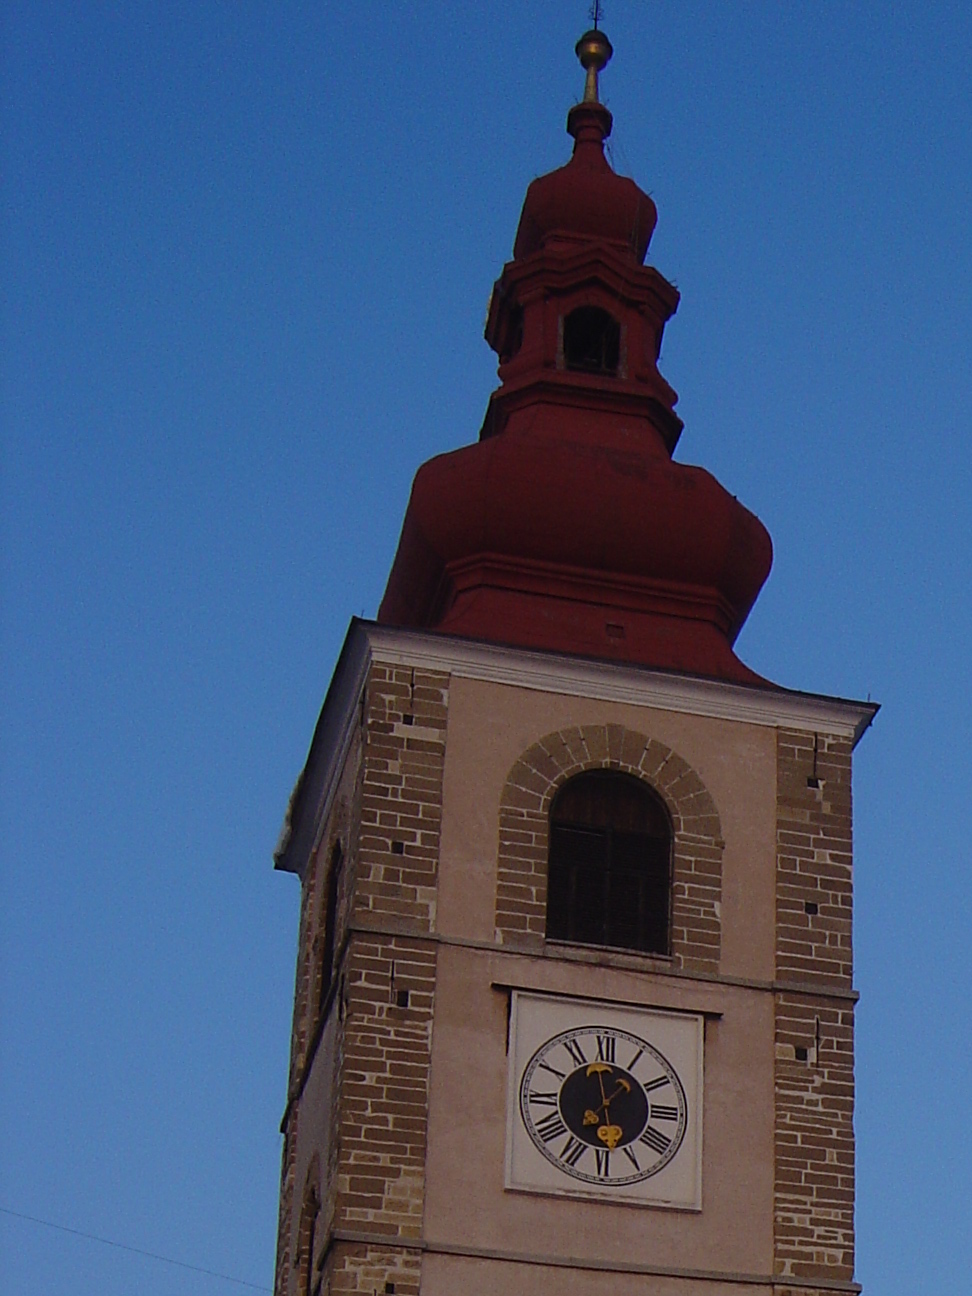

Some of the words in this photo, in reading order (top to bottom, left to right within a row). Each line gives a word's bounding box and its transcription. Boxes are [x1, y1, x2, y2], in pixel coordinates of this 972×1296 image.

[564, 1039, 587, 1067] XI
[595, 1035, 615, 1063] XII
[539, 1059, 565, 1082] X
[643, 1076, 670, 1092] II
[529, 1089, 557, 1106] IX
[535, 1110, 567, 1142] VIII
[651, 1104, 678, 1121] III
[560, 1136, 588, 1167] VII
[640, 1125, 671, 1155] IIII
[595, 1149, 609, 1177] VI
[623, 1145, 641, 1171] V
